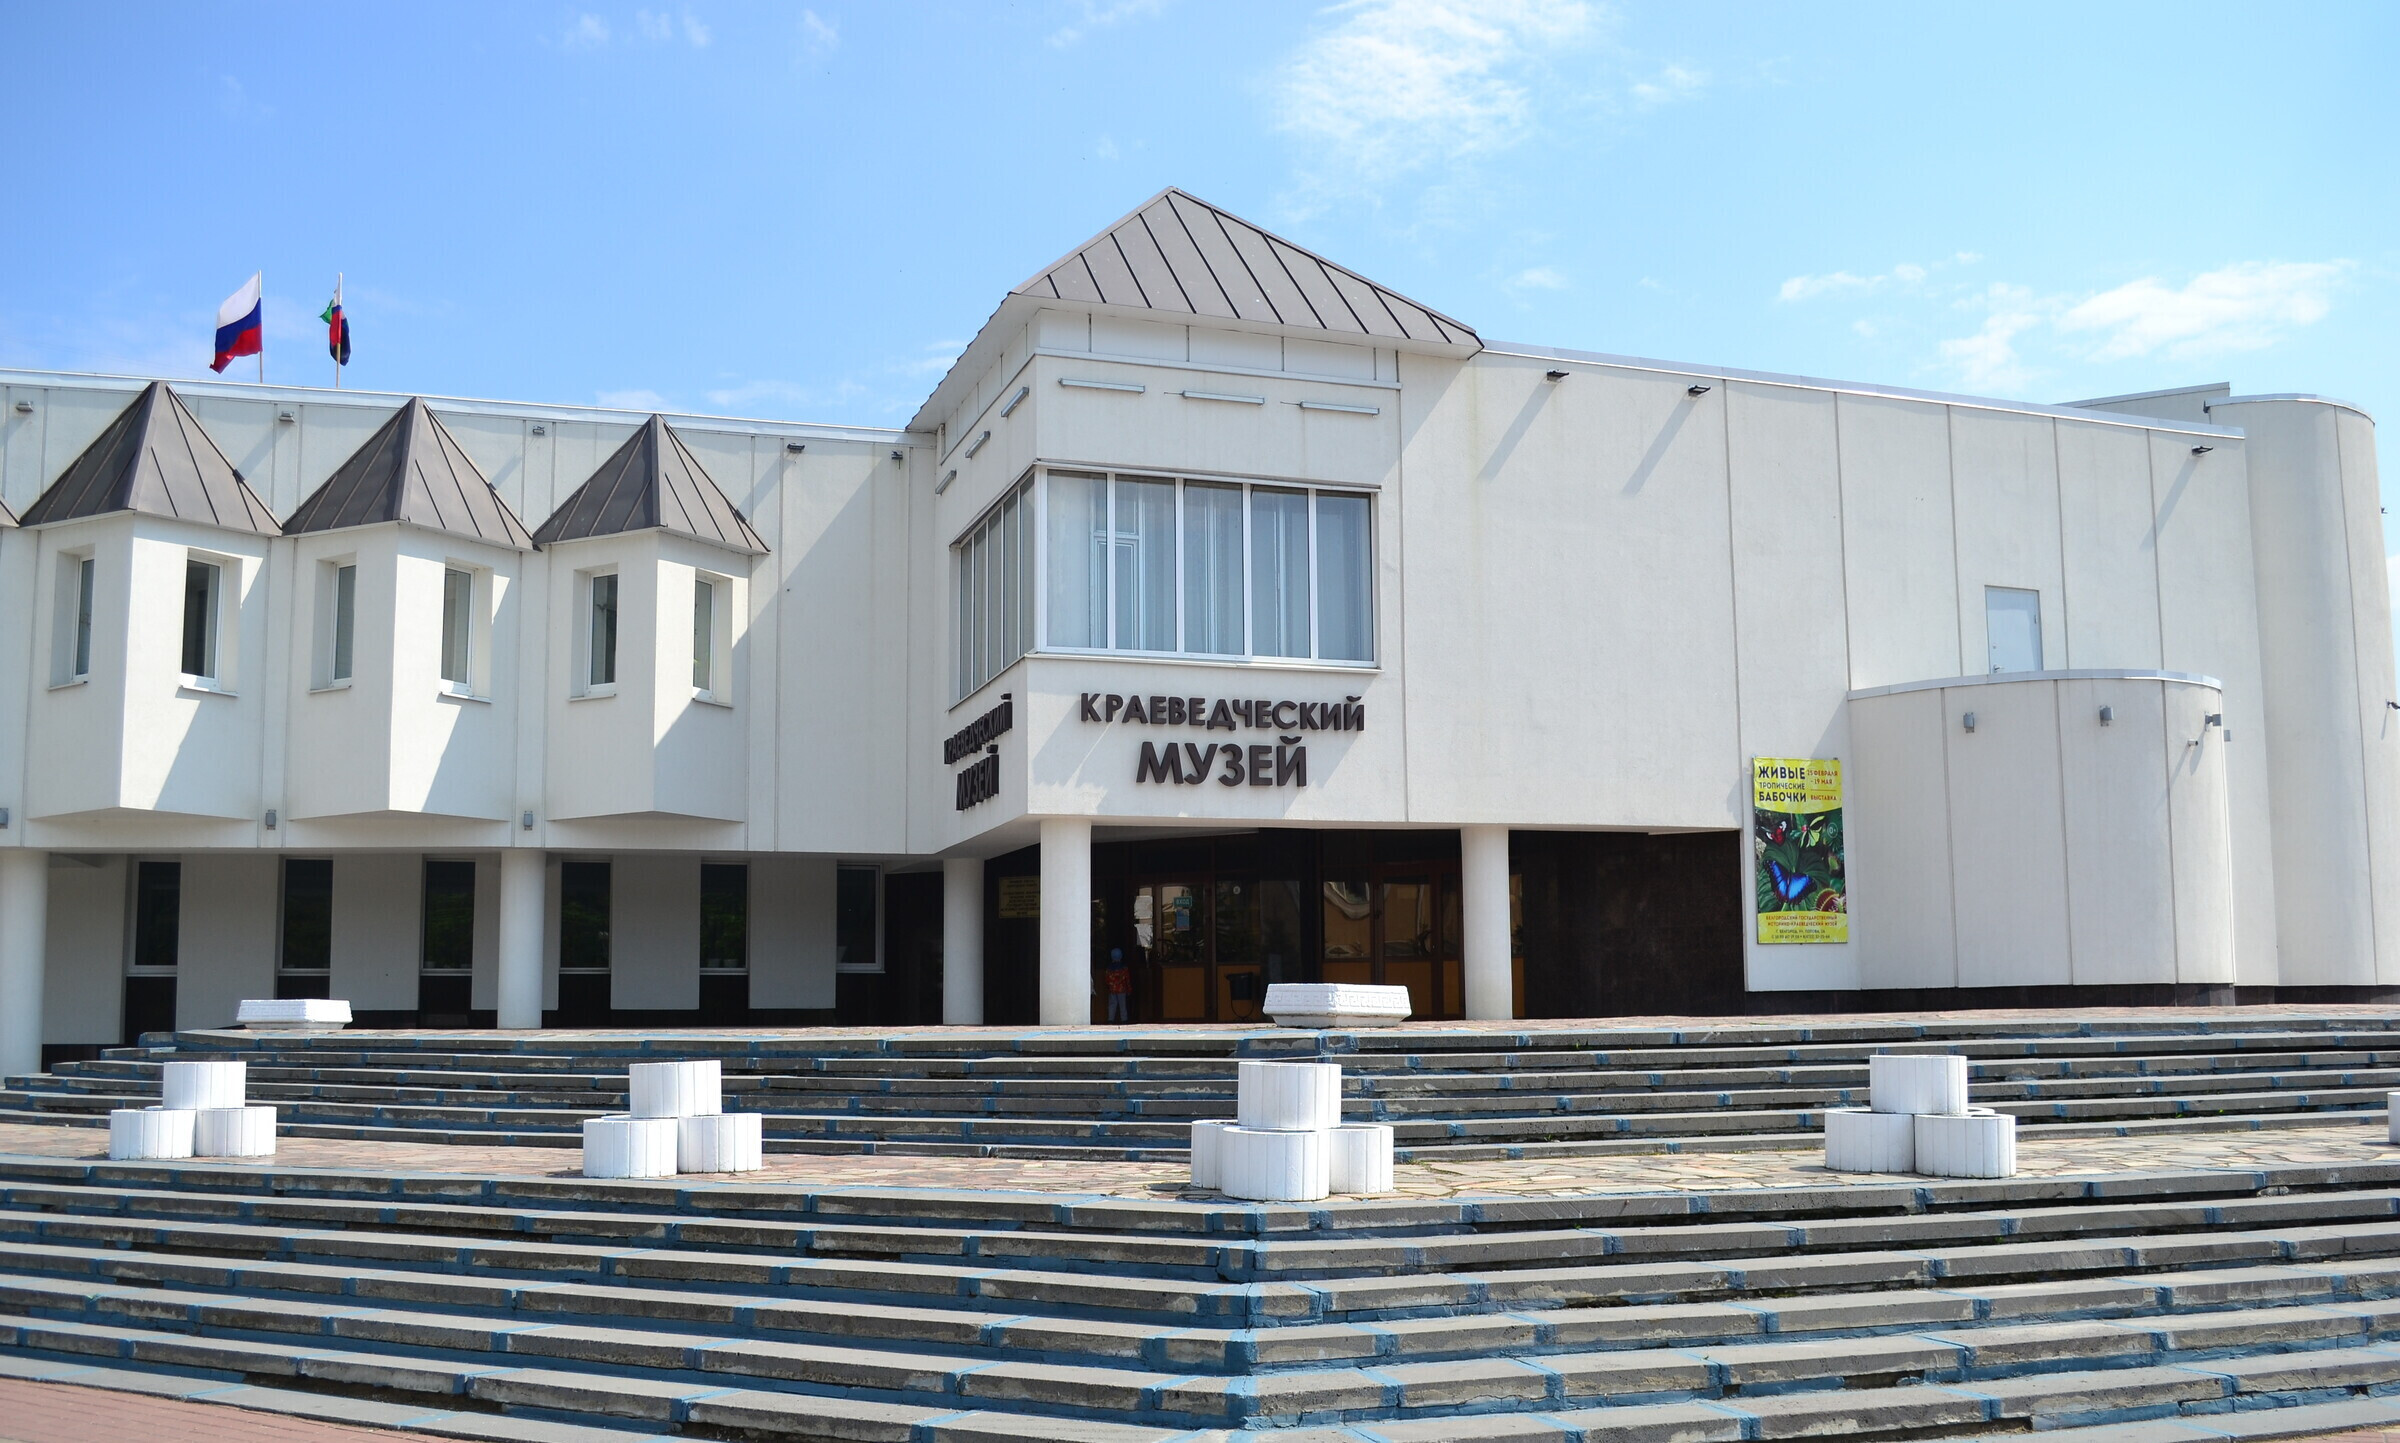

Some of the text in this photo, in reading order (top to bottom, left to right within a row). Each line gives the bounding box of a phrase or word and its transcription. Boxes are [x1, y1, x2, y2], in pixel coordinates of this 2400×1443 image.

[1080, 692, 1365, 731] КРАЕВЕДЧЕСКИЙ
[1135, 735, 1307, 787] МУЗЕЙ
[1758, 766, 1806, 779] ЖИВЫЕ
[956, 744, 1000, 811] МУЗЕЙ
[1759, 782, 1805, 790] ТРОПИЧЕСКИЕ
[1758, 791, 1807, 802] БАБОЧКИ
